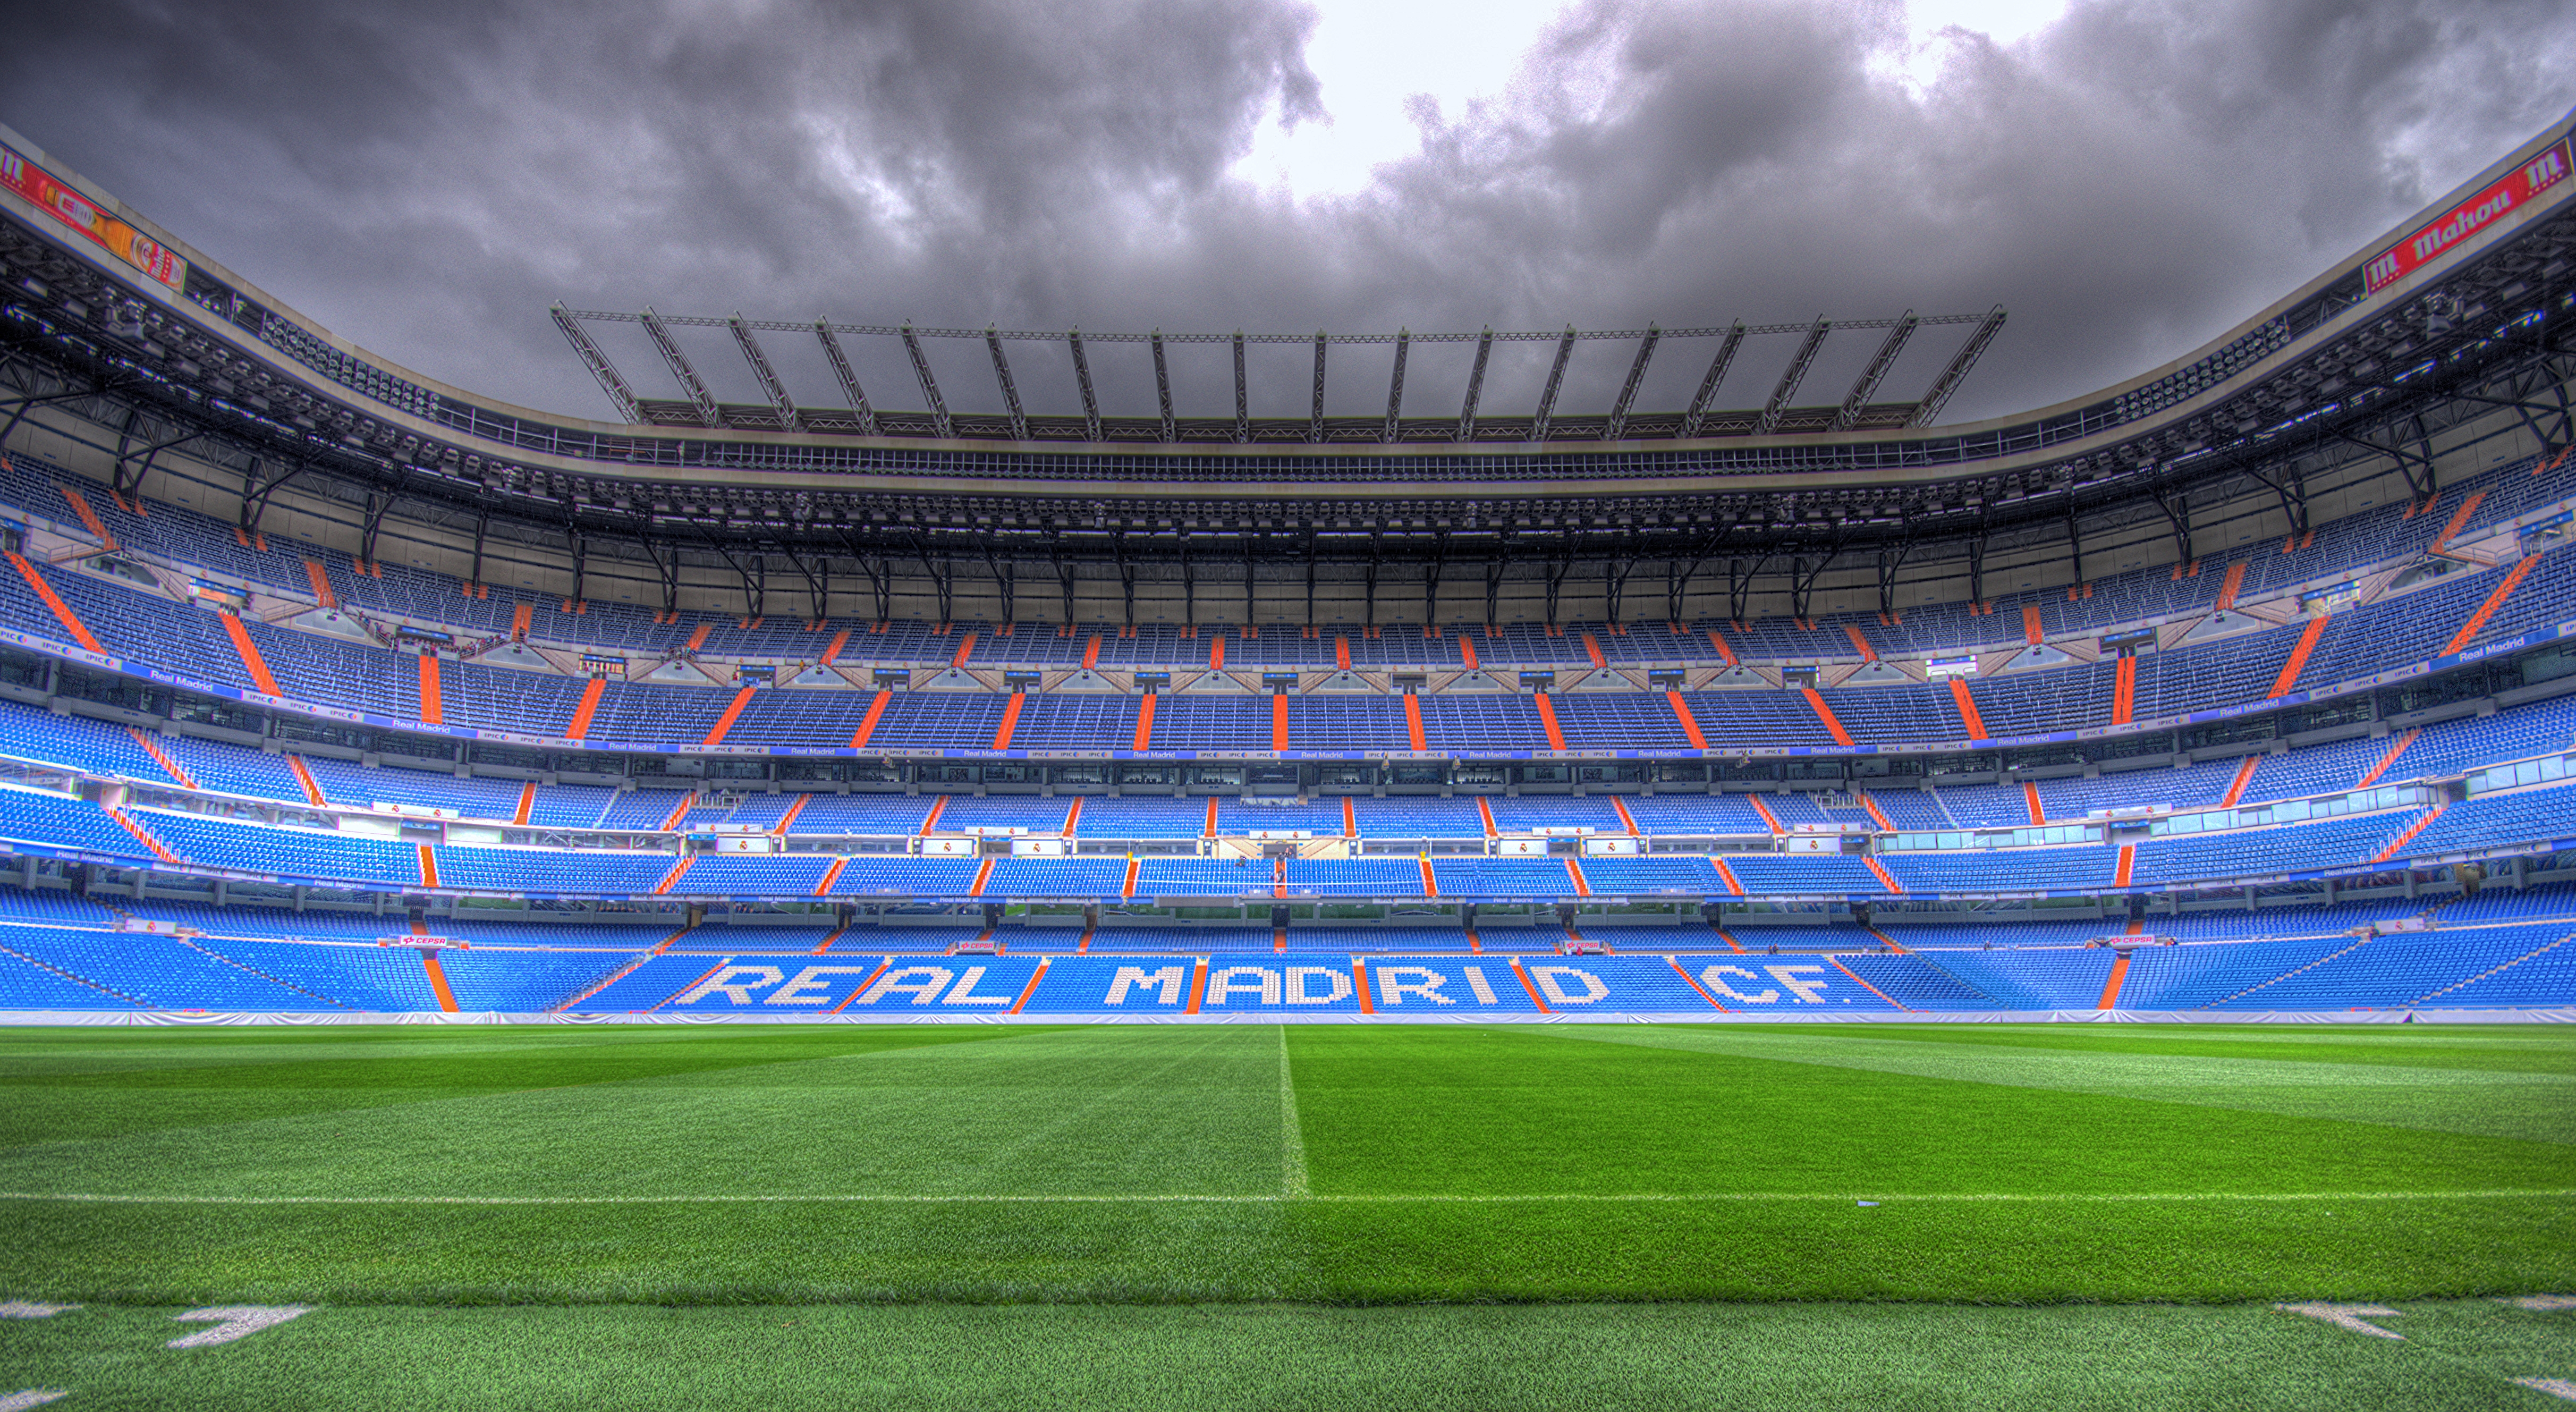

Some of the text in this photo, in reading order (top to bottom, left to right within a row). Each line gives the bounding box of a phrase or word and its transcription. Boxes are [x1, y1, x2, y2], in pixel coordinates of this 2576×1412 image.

[2412, 191, 2512, 261] Mahou
[2566, 623, 2576, 632] IP
[0, 630, 103, 663] PIC IPIC IPIC
[2459, 637, 2524, 662] Real Madrid
[150, 670, 213, 691] Real Madrid
[2395, 669, 2411, 678] IPIC
[2219, 699, 2279, 717] Real Madrid
[392, 720, 451, 733] Real Madrid
[2018, 735, 2049, 744] Madrid
[675, 966, 1011, 1005] REAL
[1104, 966, 1609, 1005] MADRID
